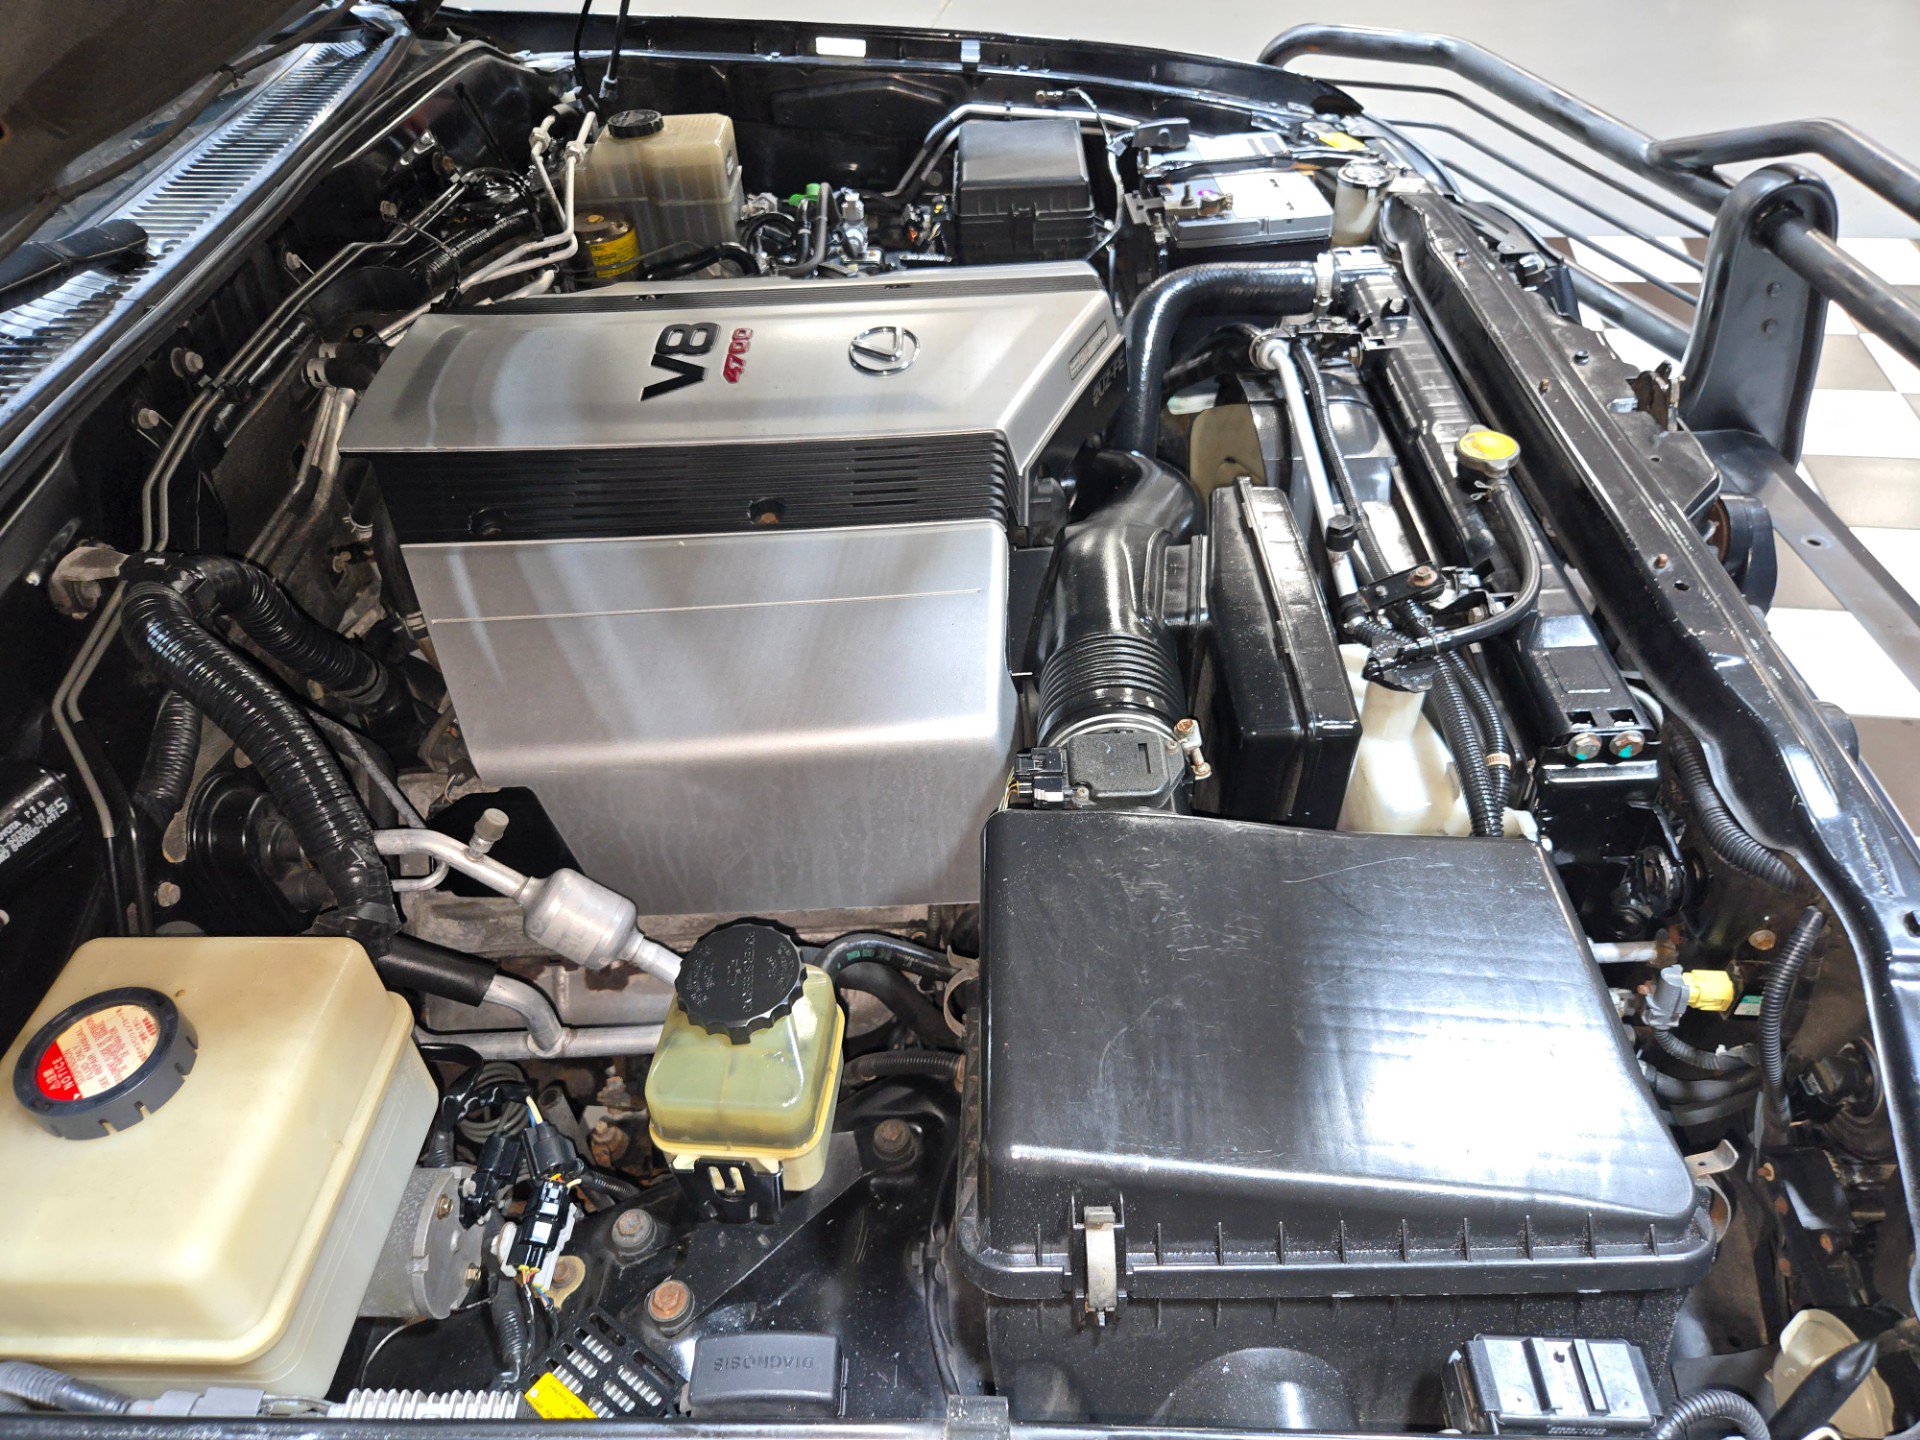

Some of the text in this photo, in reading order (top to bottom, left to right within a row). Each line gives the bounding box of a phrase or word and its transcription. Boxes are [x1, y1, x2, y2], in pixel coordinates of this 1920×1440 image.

[640, 322, 722, 402] V8
[722, 327, 754, 384] 4700
[51, 1056, 74, 1091] NOTICE
[713, 1355, 815, 1372] DIAGNOSIS
